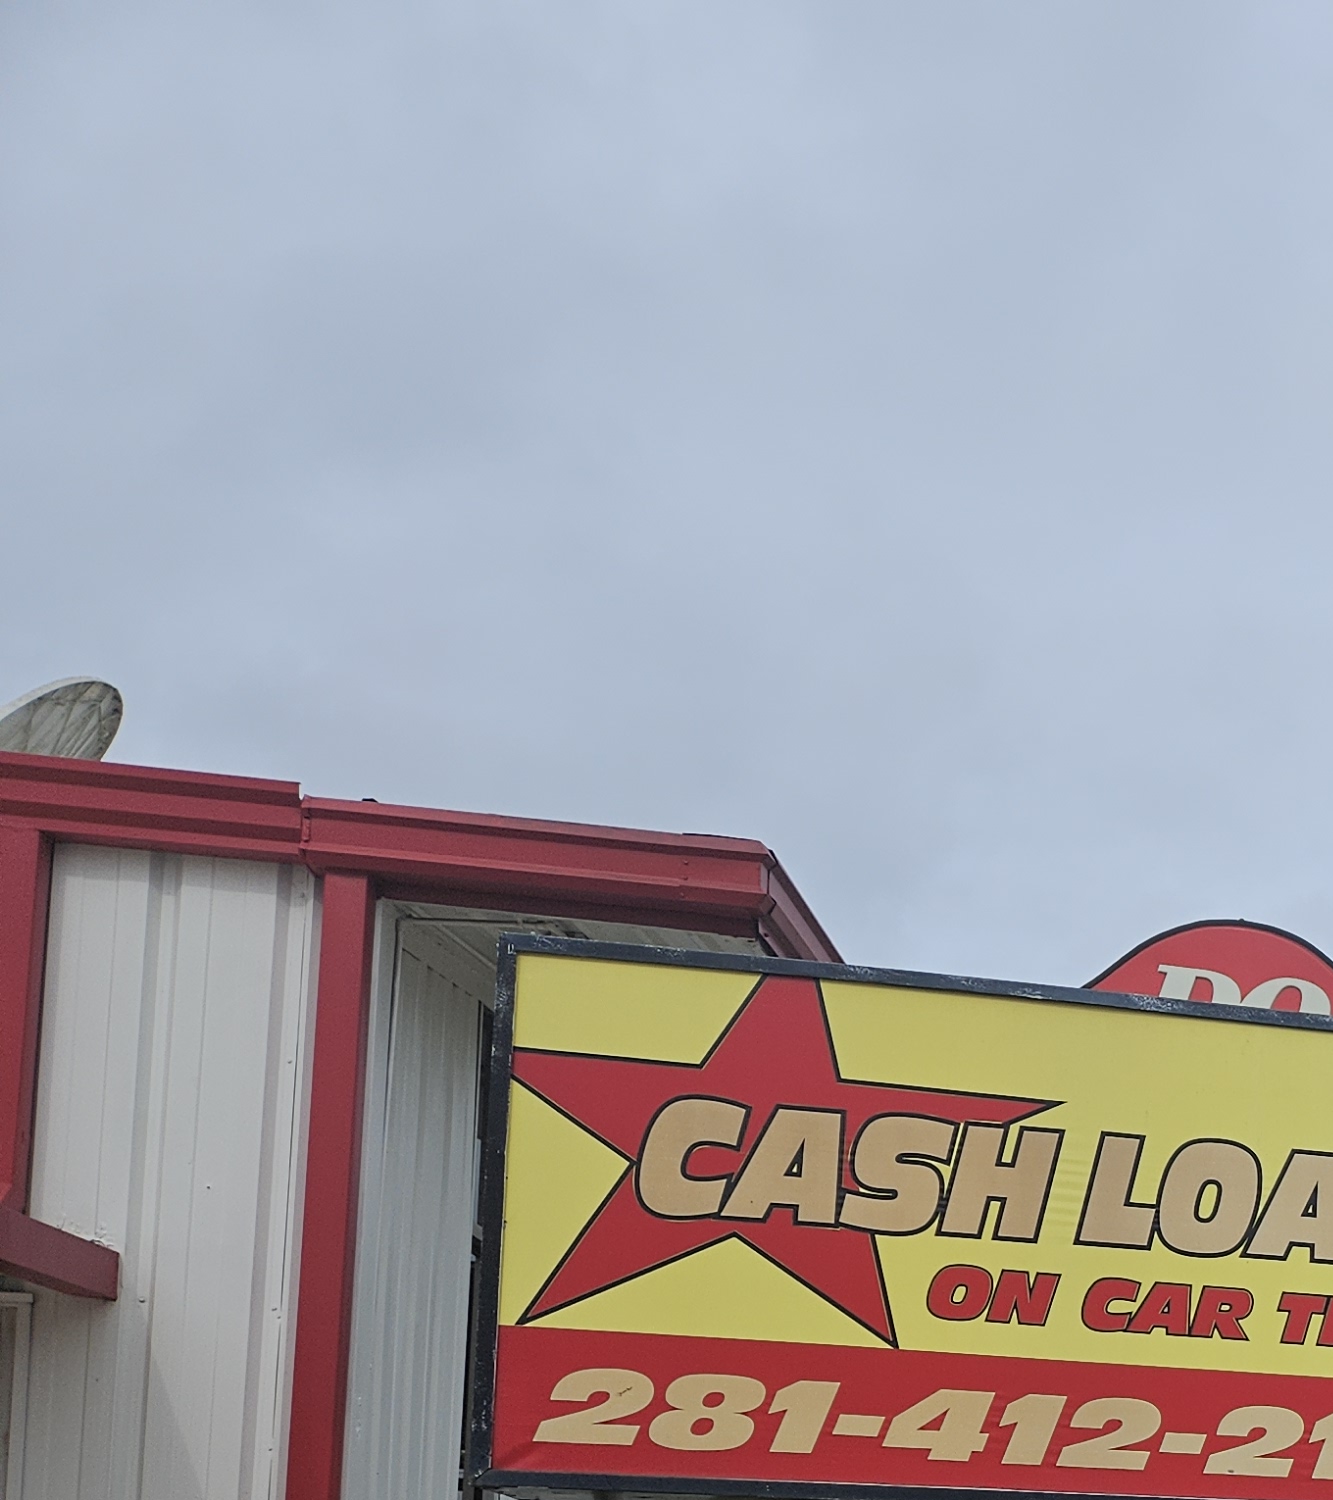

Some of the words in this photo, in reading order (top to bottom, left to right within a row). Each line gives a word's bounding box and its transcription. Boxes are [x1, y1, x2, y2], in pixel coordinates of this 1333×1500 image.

[634, 1094, 1065, 1243] CASH
[926, 1263, 1061, 1327] ON
[1081, 1276, 1253, 1342] CAR
